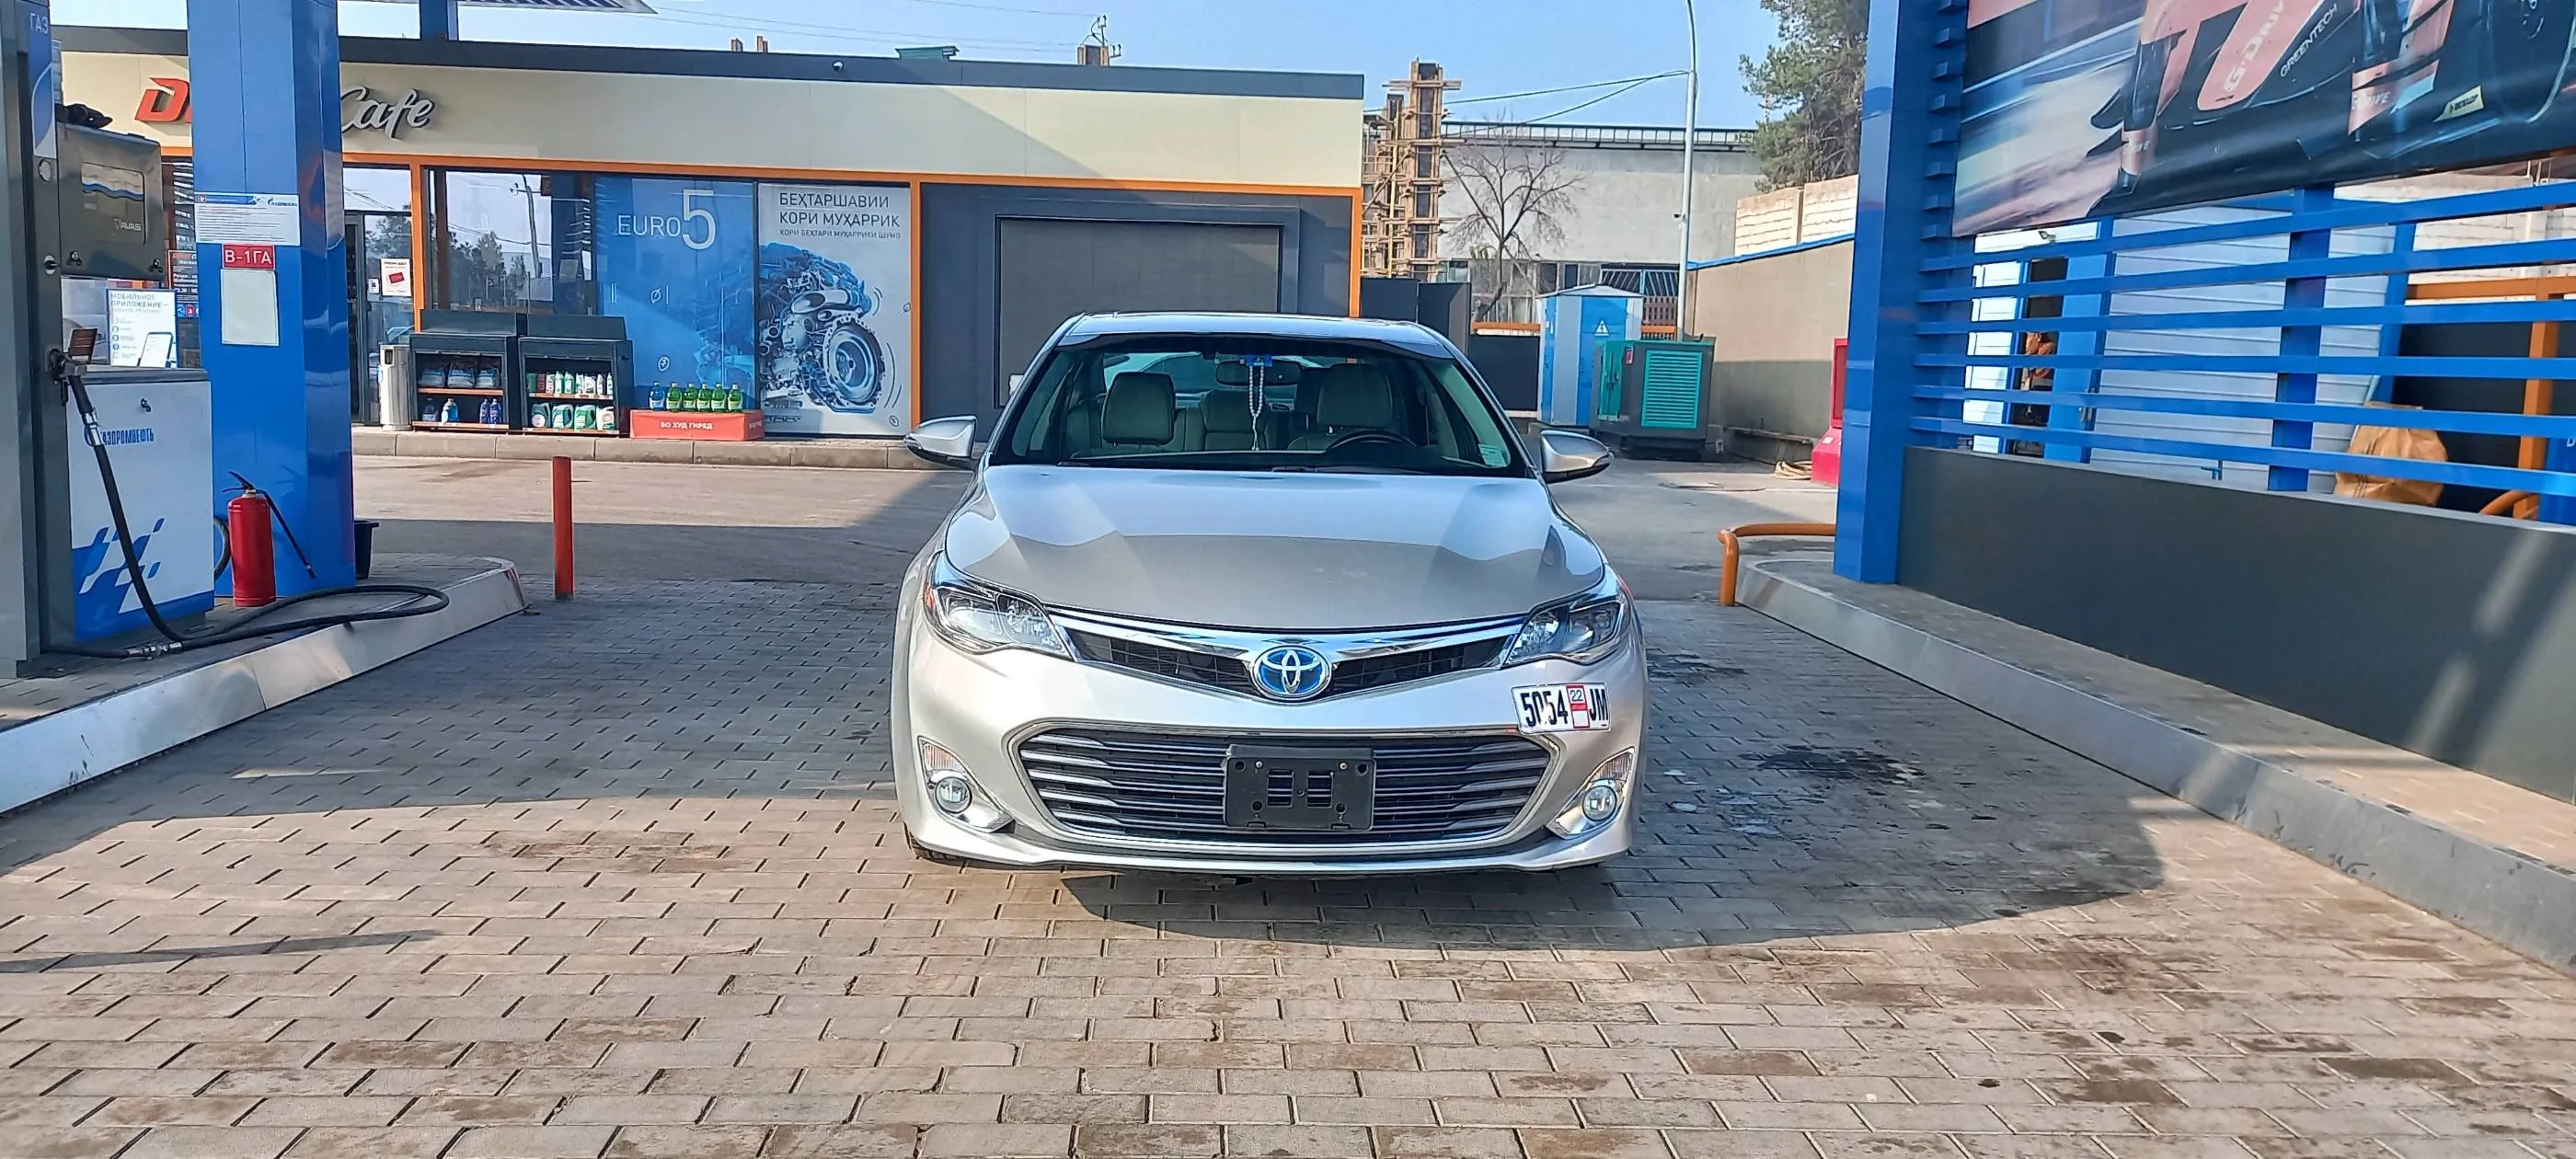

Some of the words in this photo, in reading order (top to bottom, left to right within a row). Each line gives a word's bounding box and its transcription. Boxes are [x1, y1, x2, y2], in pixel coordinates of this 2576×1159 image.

[29, 12, 49, 34] ГАЗ
[2281, 3, 2338, 77] GREENTECH
[340, 86, 435, 139] Cafe
[779, 192, 889, 209] БЕҲТАРШАВИИ
[779, 212, 818, 225] КОРИ
[822, 212, 901, 228] МУҲАРРИК
[224, 249, 272, 265] В-1ГА
[1520, 689, 1569, 727] 5054
[1570, 689, 1584, 702] 22
[1589, 688, 1609, 722] JM
